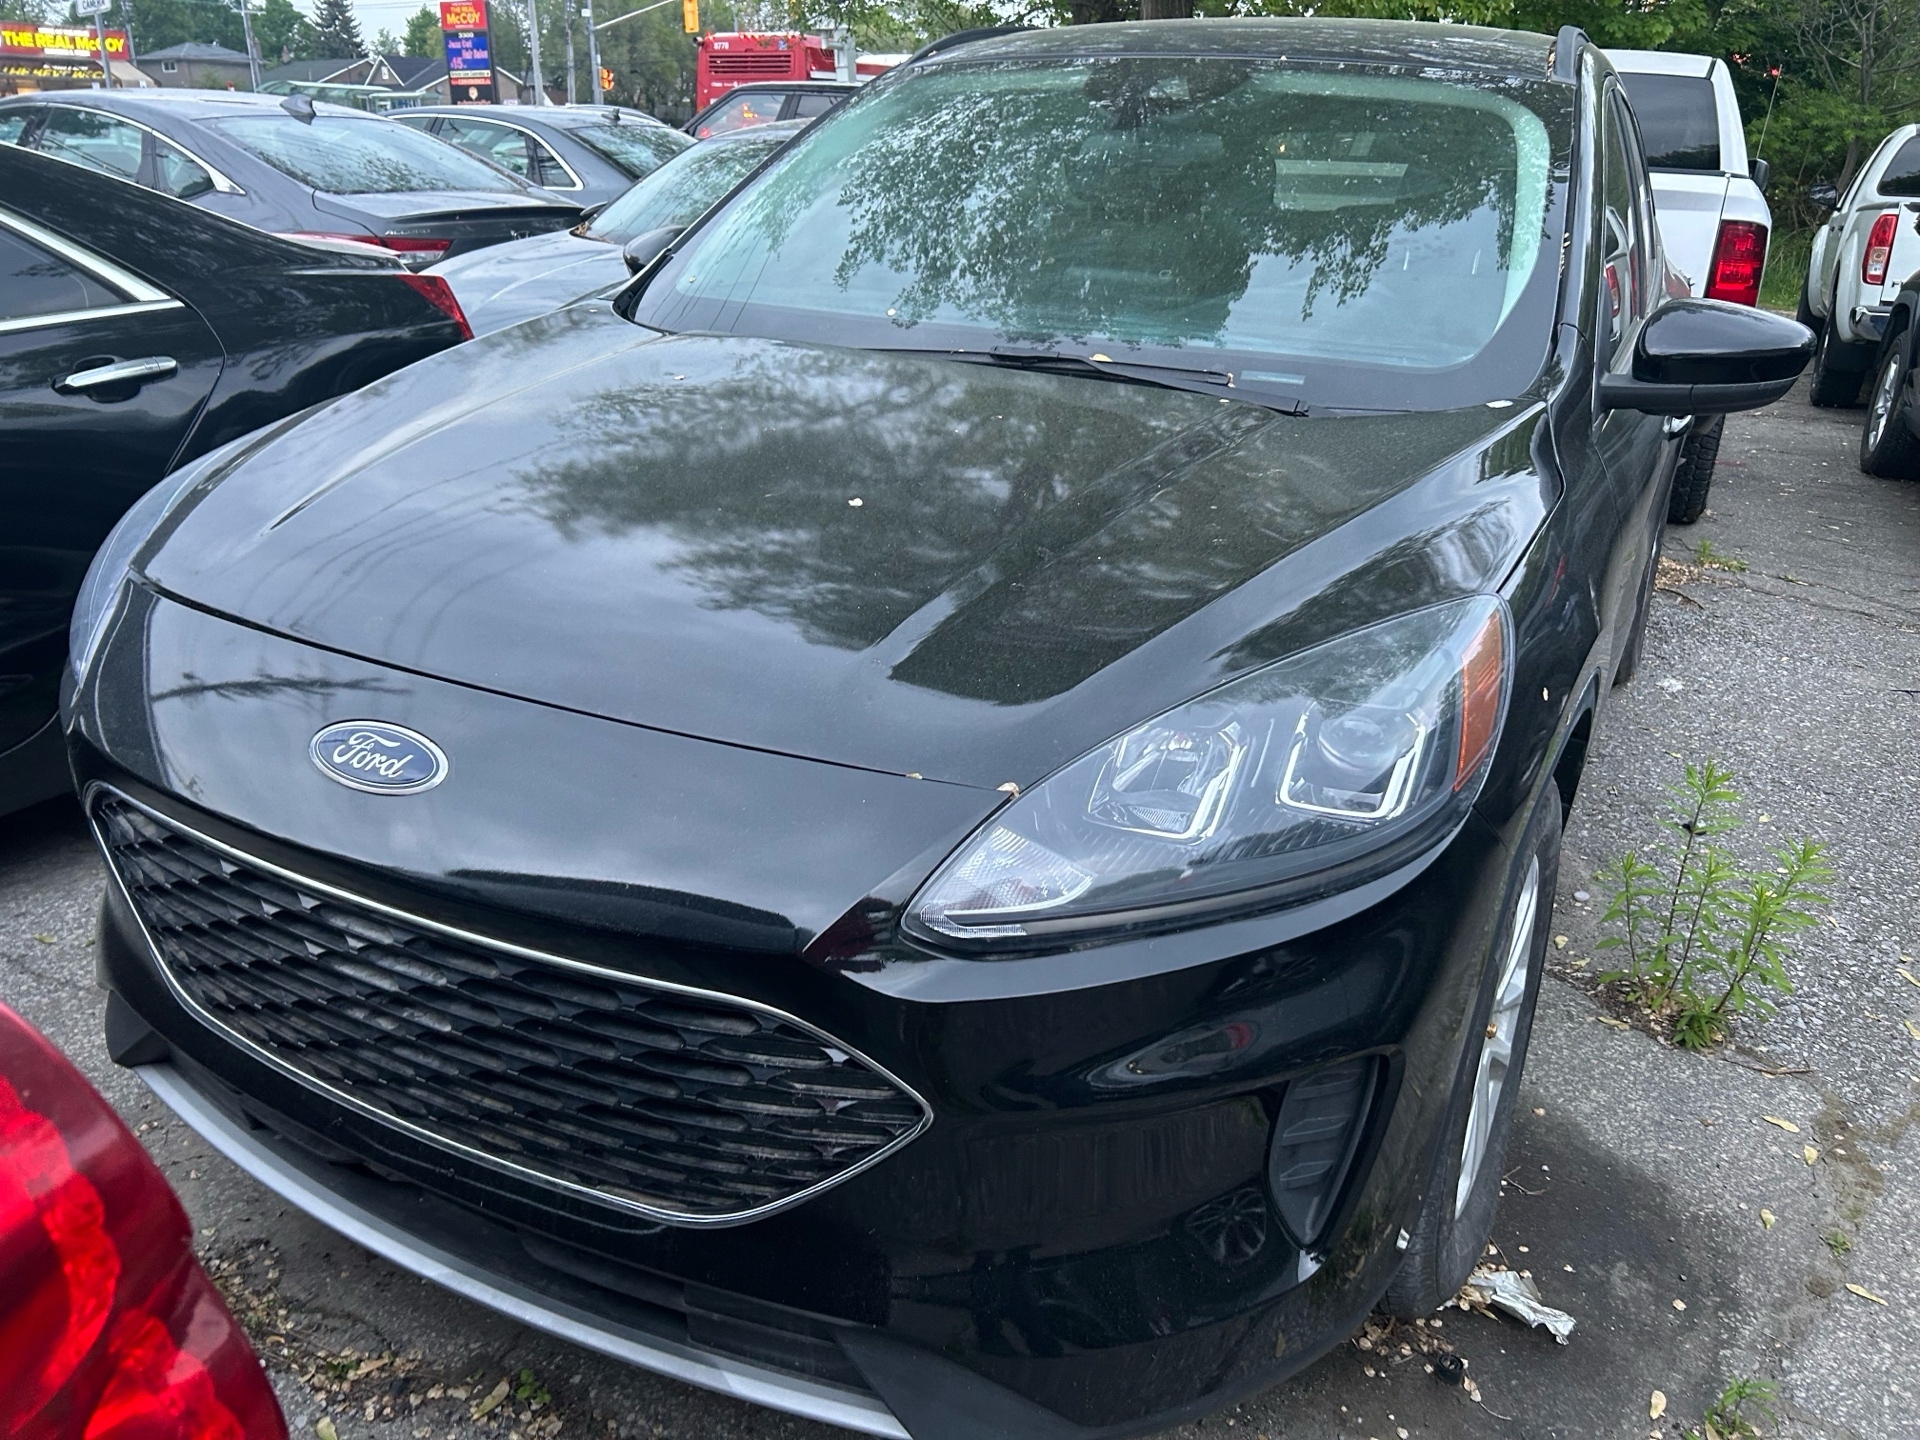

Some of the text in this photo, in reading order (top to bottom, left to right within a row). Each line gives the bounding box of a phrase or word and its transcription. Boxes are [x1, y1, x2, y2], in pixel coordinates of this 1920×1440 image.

[446, 11, 480, 25] McCOY
[1, 30, 35, 47] THE
[35, 33, 75, 50] REAL
[333, 732, 414, 778] Ford
